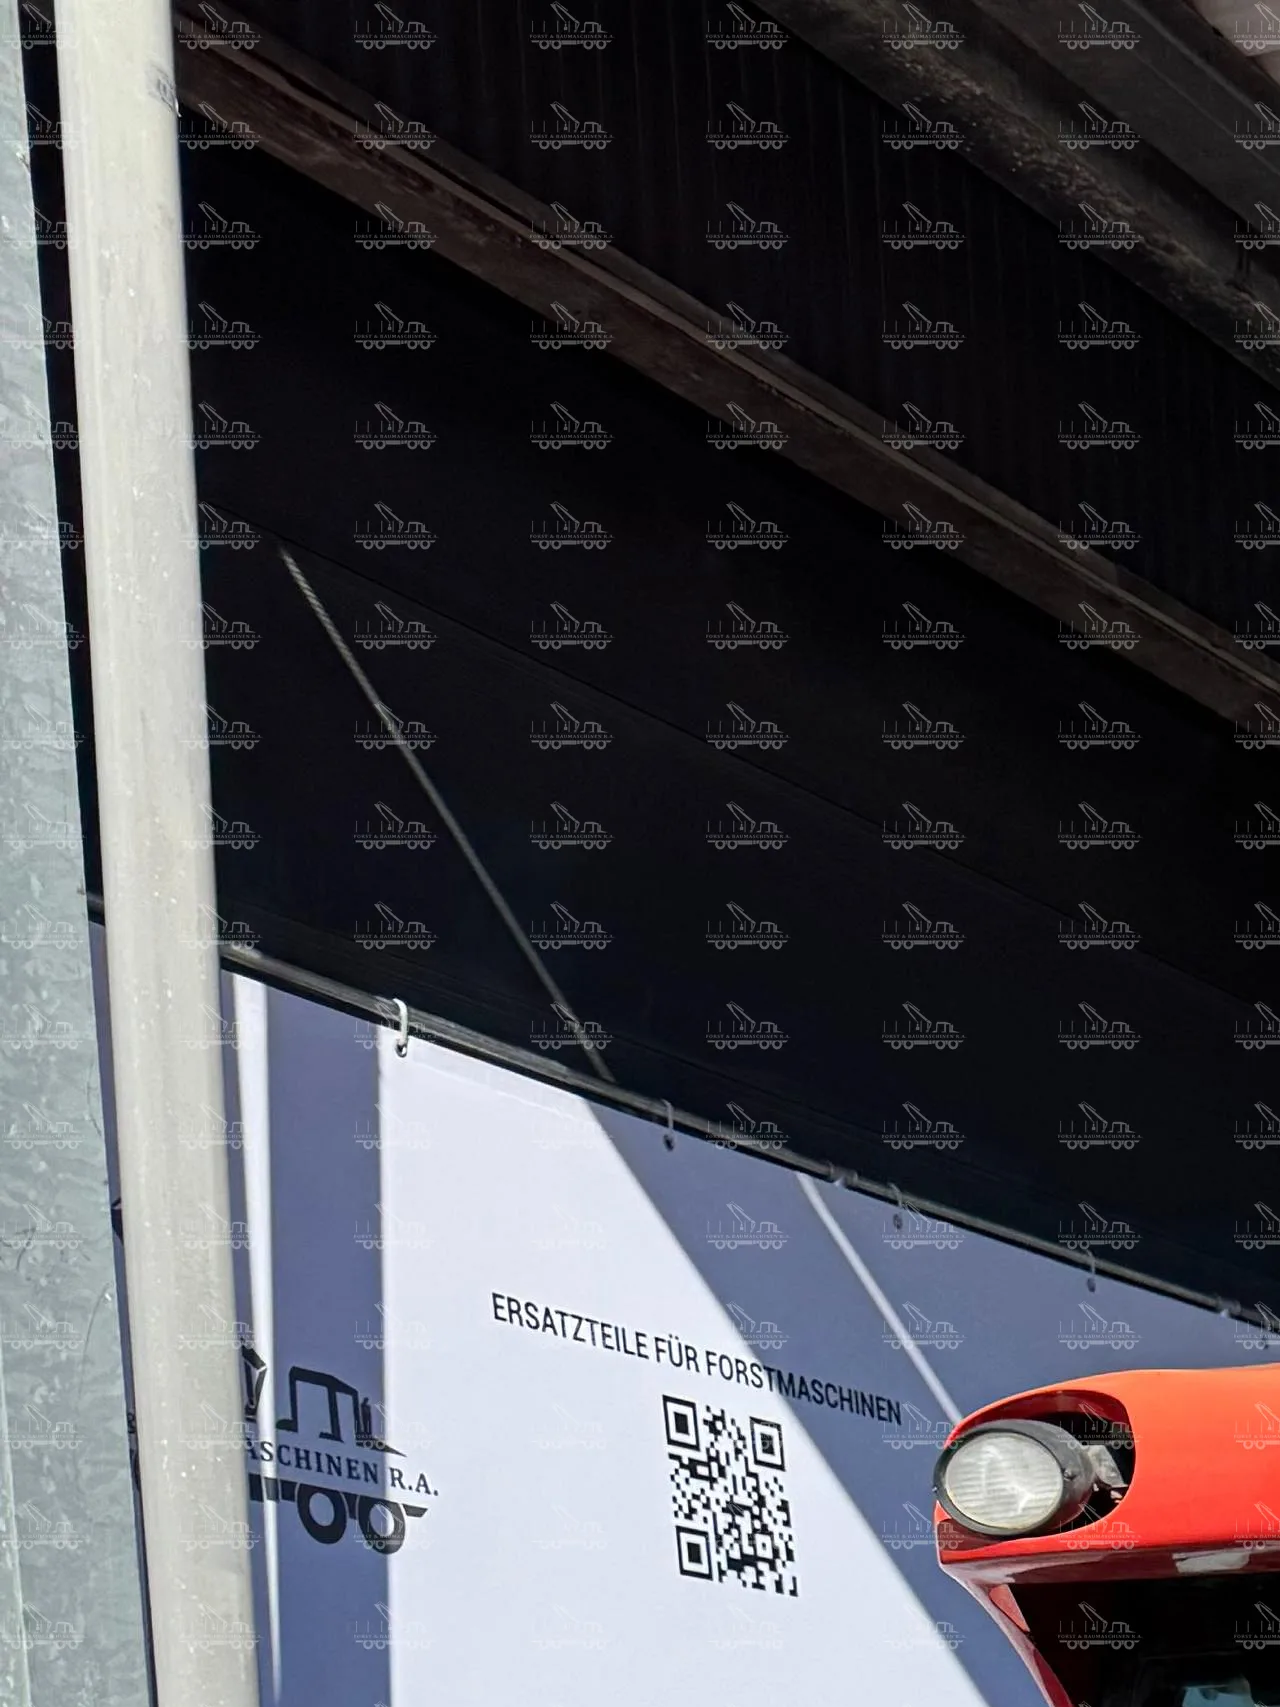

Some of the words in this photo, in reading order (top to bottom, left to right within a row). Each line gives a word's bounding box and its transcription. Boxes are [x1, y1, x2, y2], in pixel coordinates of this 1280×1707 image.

[491, 1292, 649, 1360] ERSATZTEILE
[654, 1333, 700, 1374] FÜR
[704, 1351, 902, 1426] FORSTMASCHINEN
[389, 1467, 439, 1496] R.A.
